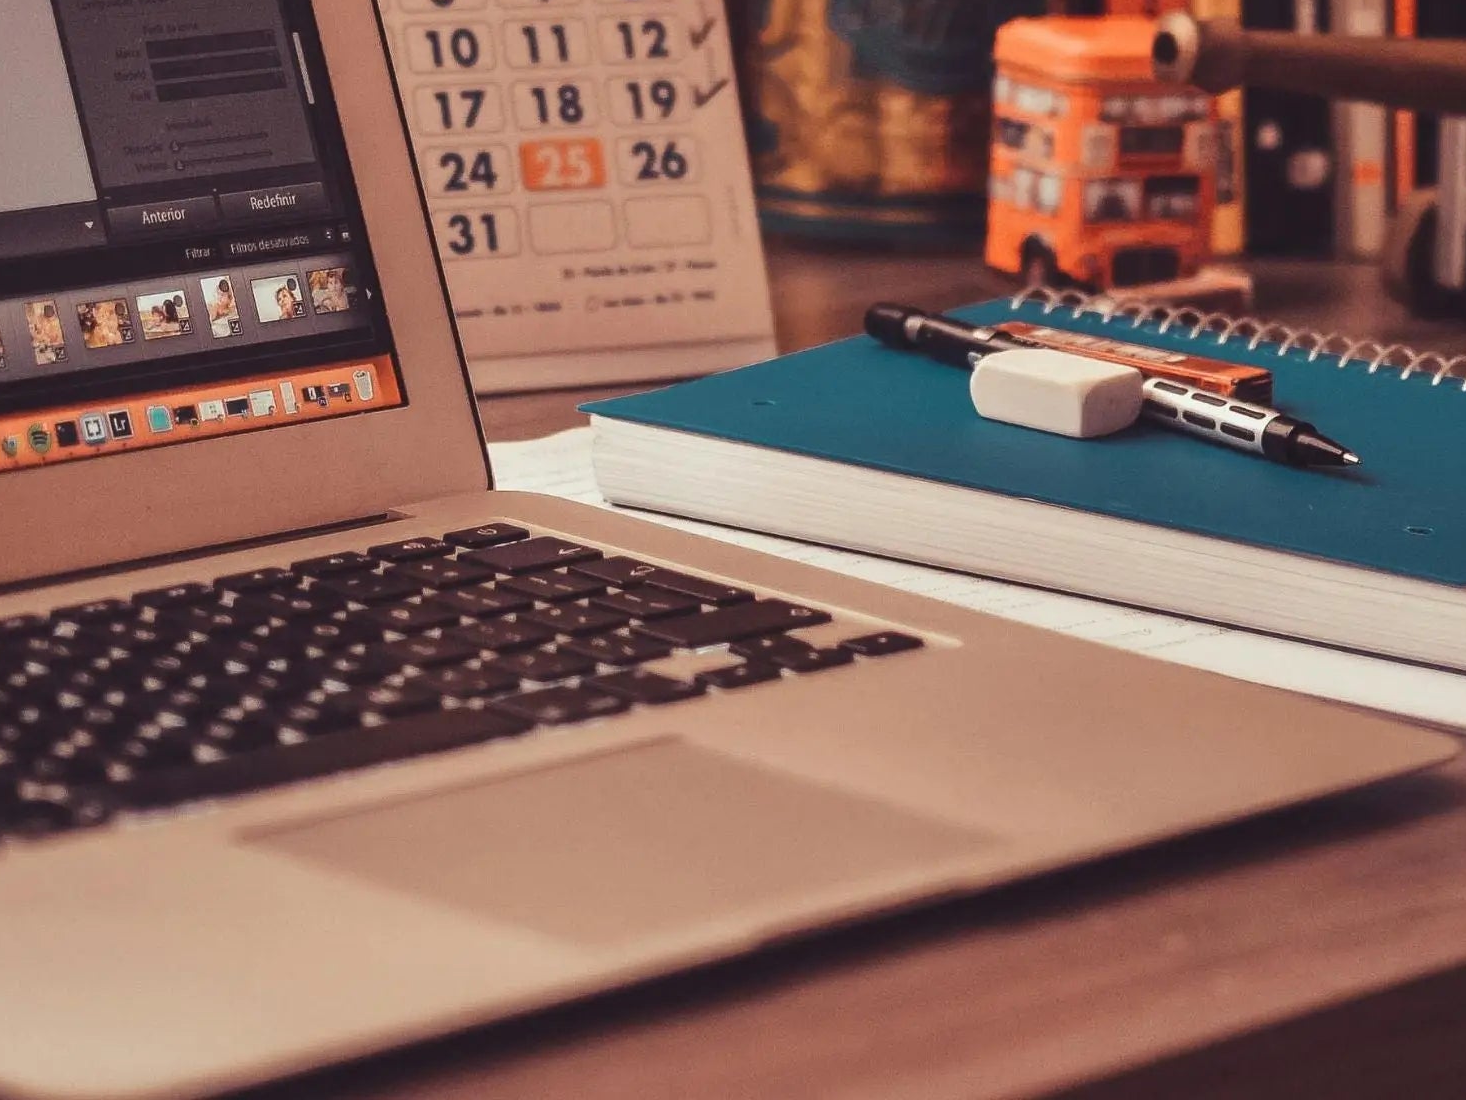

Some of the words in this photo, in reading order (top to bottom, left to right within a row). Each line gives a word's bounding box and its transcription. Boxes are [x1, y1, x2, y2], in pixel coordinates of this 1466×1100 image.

[424, 27, 480, 69] 10
[521, 24, 570, 64] 11
[616, 20, 670, 60] 12
[435, 89, 486, 130] 17
[530, 84, 584, 125] 18
[626, 80, 677, 120] 19
[439, 151, 498, 193] 24
[534, 145, 593, 187] 25
[631, 141, 688, 181] 26
[142, 207, 186, 225] Anterior
[250, 193, 297, 210] Redefinir
[230, 242, 258, 255] Filtros
[448, 213, 499, 256] 31
[113, 417, 126, 434] Lr
